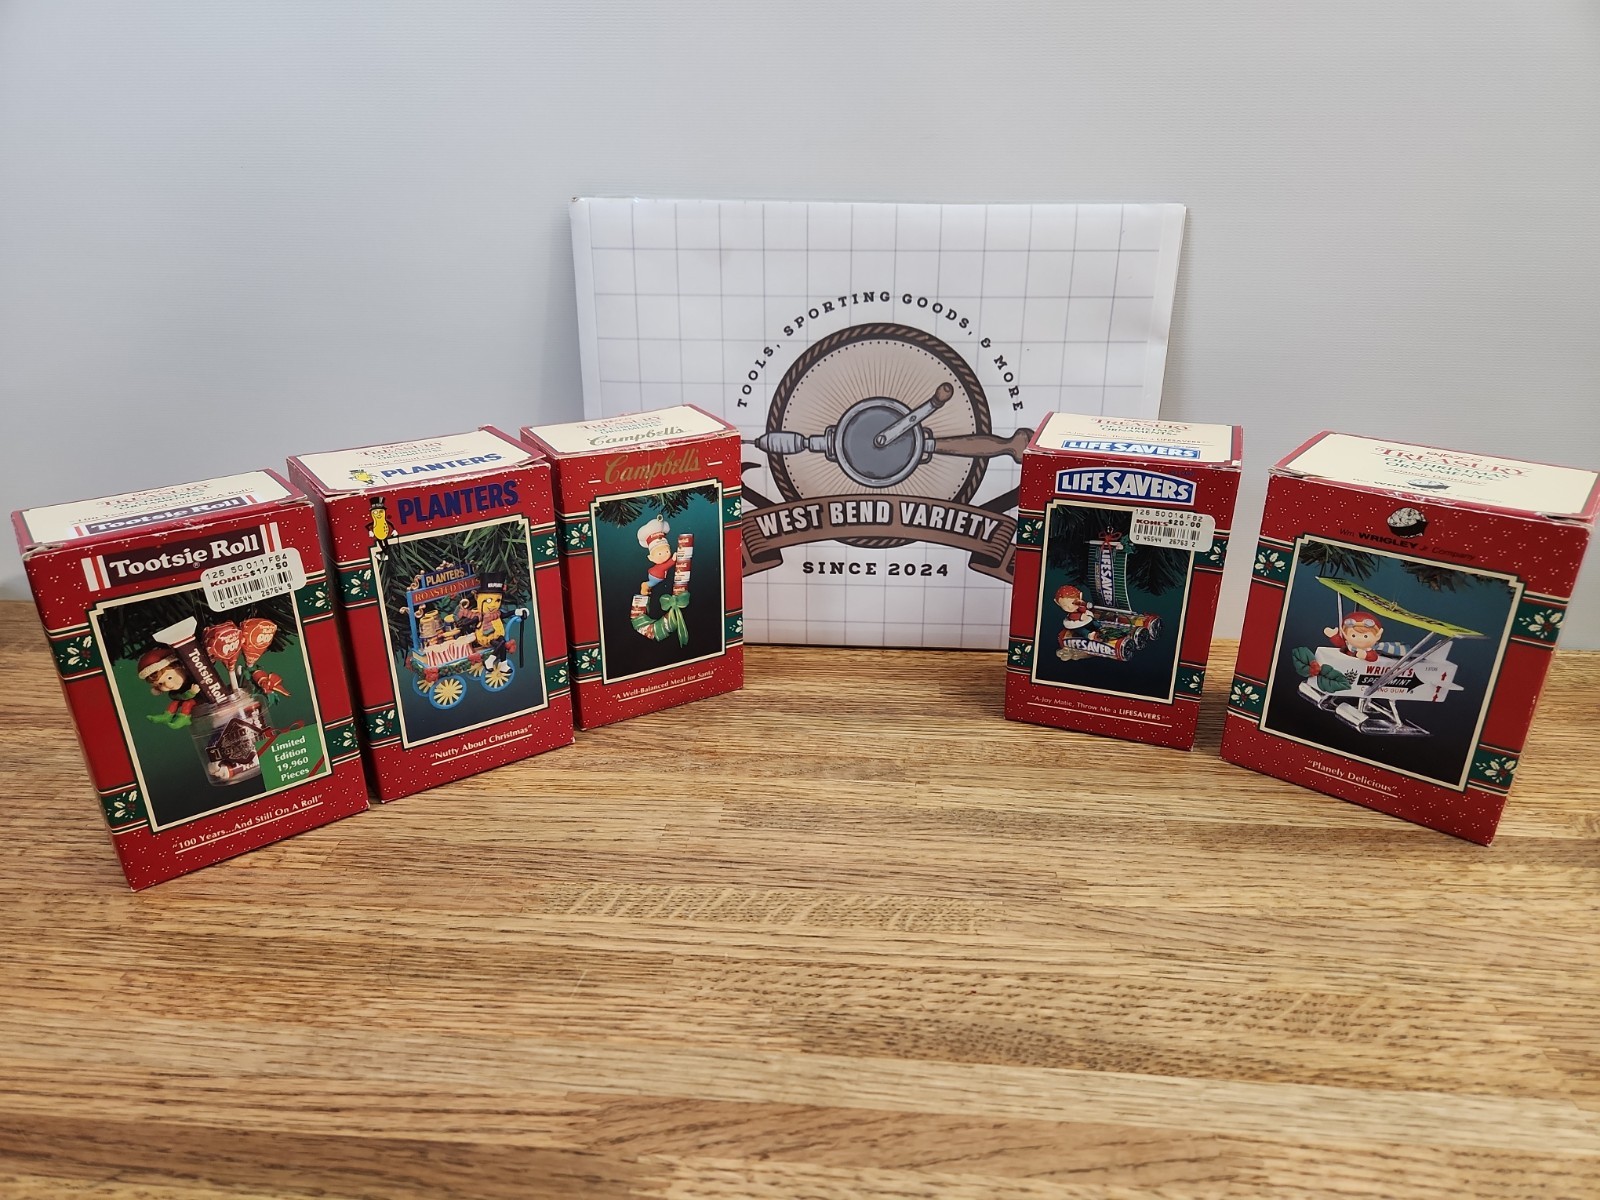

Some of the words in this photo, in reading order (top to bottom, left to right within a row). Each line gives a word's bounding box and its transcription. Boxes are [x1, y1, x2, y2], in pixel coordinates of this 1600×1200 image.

[736, 344, 781, 408] TOOLS,
[783, 291, 891, 336] SPORTING
[902, 293, 972, 336] GOODS,
[980, 337, 992, 349] &
[993, 354, 1024, 412] MORE
[380, 453, 502, 478] PLANTERS
[604, 448, 701, 486] Campbell's
[397, 479, 519, 525] PLANTERS
[90, 508, 190, 531] Tootsie
[188, 498, 242, 512] Roll
[755, 504, 821, 537] WEST
[829, 501, 891, 524] BEND
[900, 502, 999, 541] VARIETY
[1168, 519, 1201, 528] $20.00
[109, 547, 208, 579] Tootsie
[209, 533, 261, 560] Roll
[1358, 531, 1419, 549] WRIGLEY
[1431, 546, 1476, 561] Company
[250, 560, 289, 577] $17.50
[425, 568, 465, 587] PLANTERS
[802, 561, 877, 575] SINCE
[887, 563, 948, 577] 2024
[414, 584, 458, 602] ROASTED
[188, 647, 214, 686] Tootsie
[208, 681, 228, 704] Roll
[622, 681, 669, 698] Well-Balanced
[670, 675, 686, 687] Meal
[1076, 702, 1098, 711] Throw
[1099, 705, 1111, 713] Me
[270, 735, 306, 753] Limited
[461, 738, 487, 752] About
[274, 747, 307, 763] Edition
[277, 756, 309, 772] 19,960
[280, 767, 310, 782] Pieces
[255, 811, 273, 824] Still
[274, 807, 290, 817] On
[292, 803, 299, 811] A
